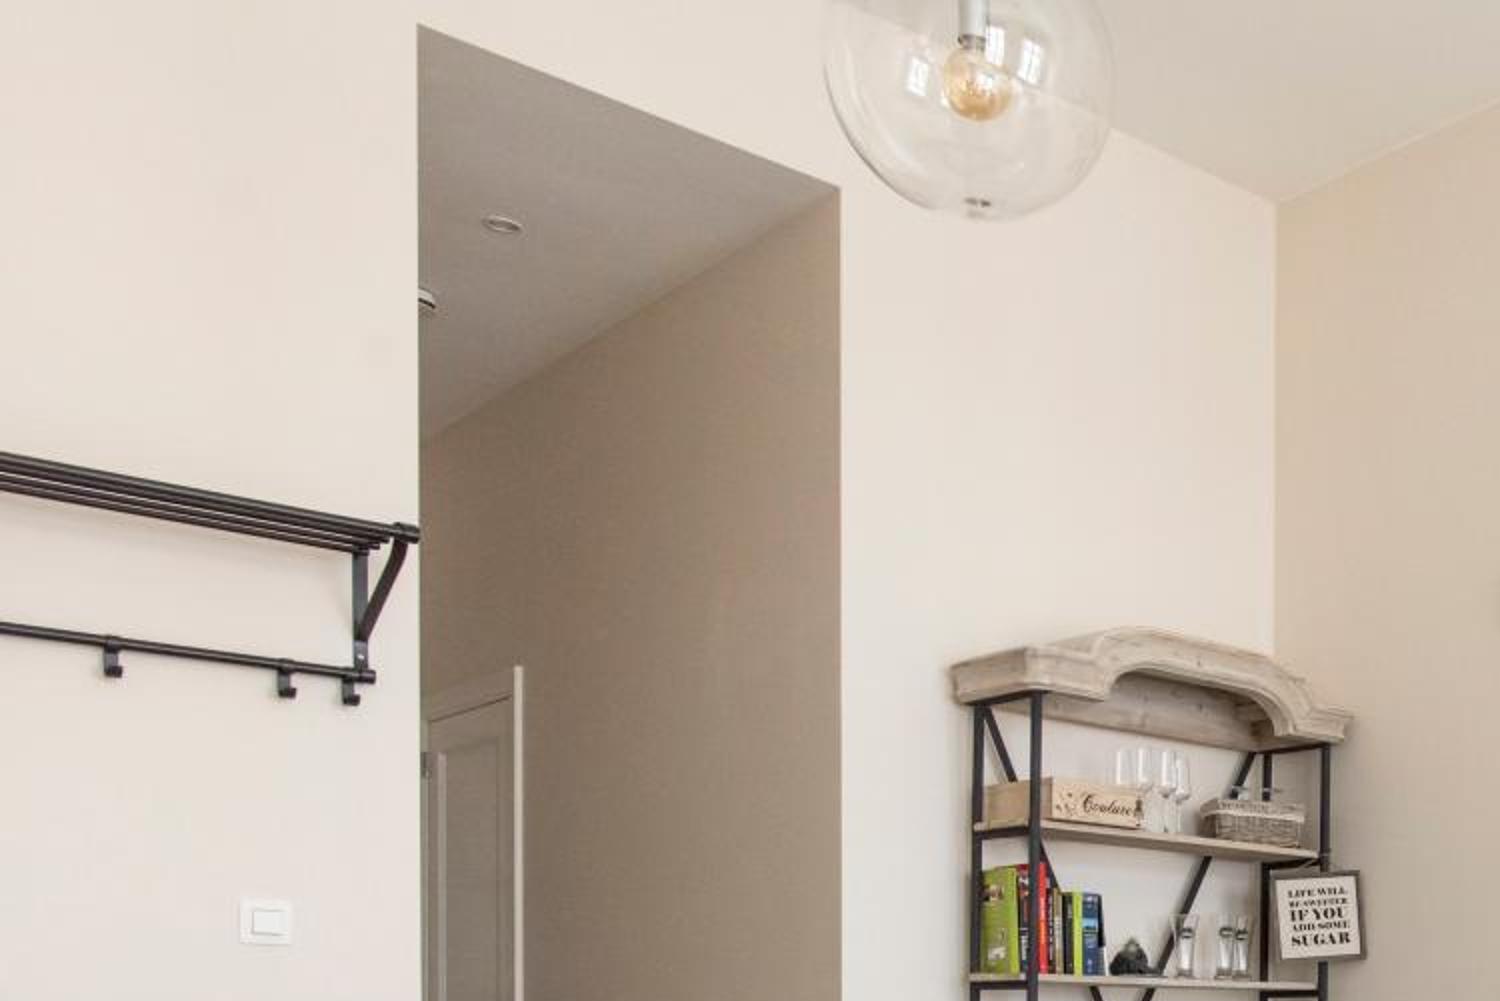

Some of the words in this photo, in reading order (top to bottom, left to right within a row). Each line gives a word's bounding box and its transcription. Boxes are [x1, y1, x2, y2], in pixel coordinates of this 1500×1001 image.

[1288, 889, 1314, 898] LIFE
[1317, 887, 1346, 895] WILL
[1289, 909, 1309, 922] IF
[1313, 907, 1348, 920] YOU
[1291, 932, 1351, 946] SUGAR
